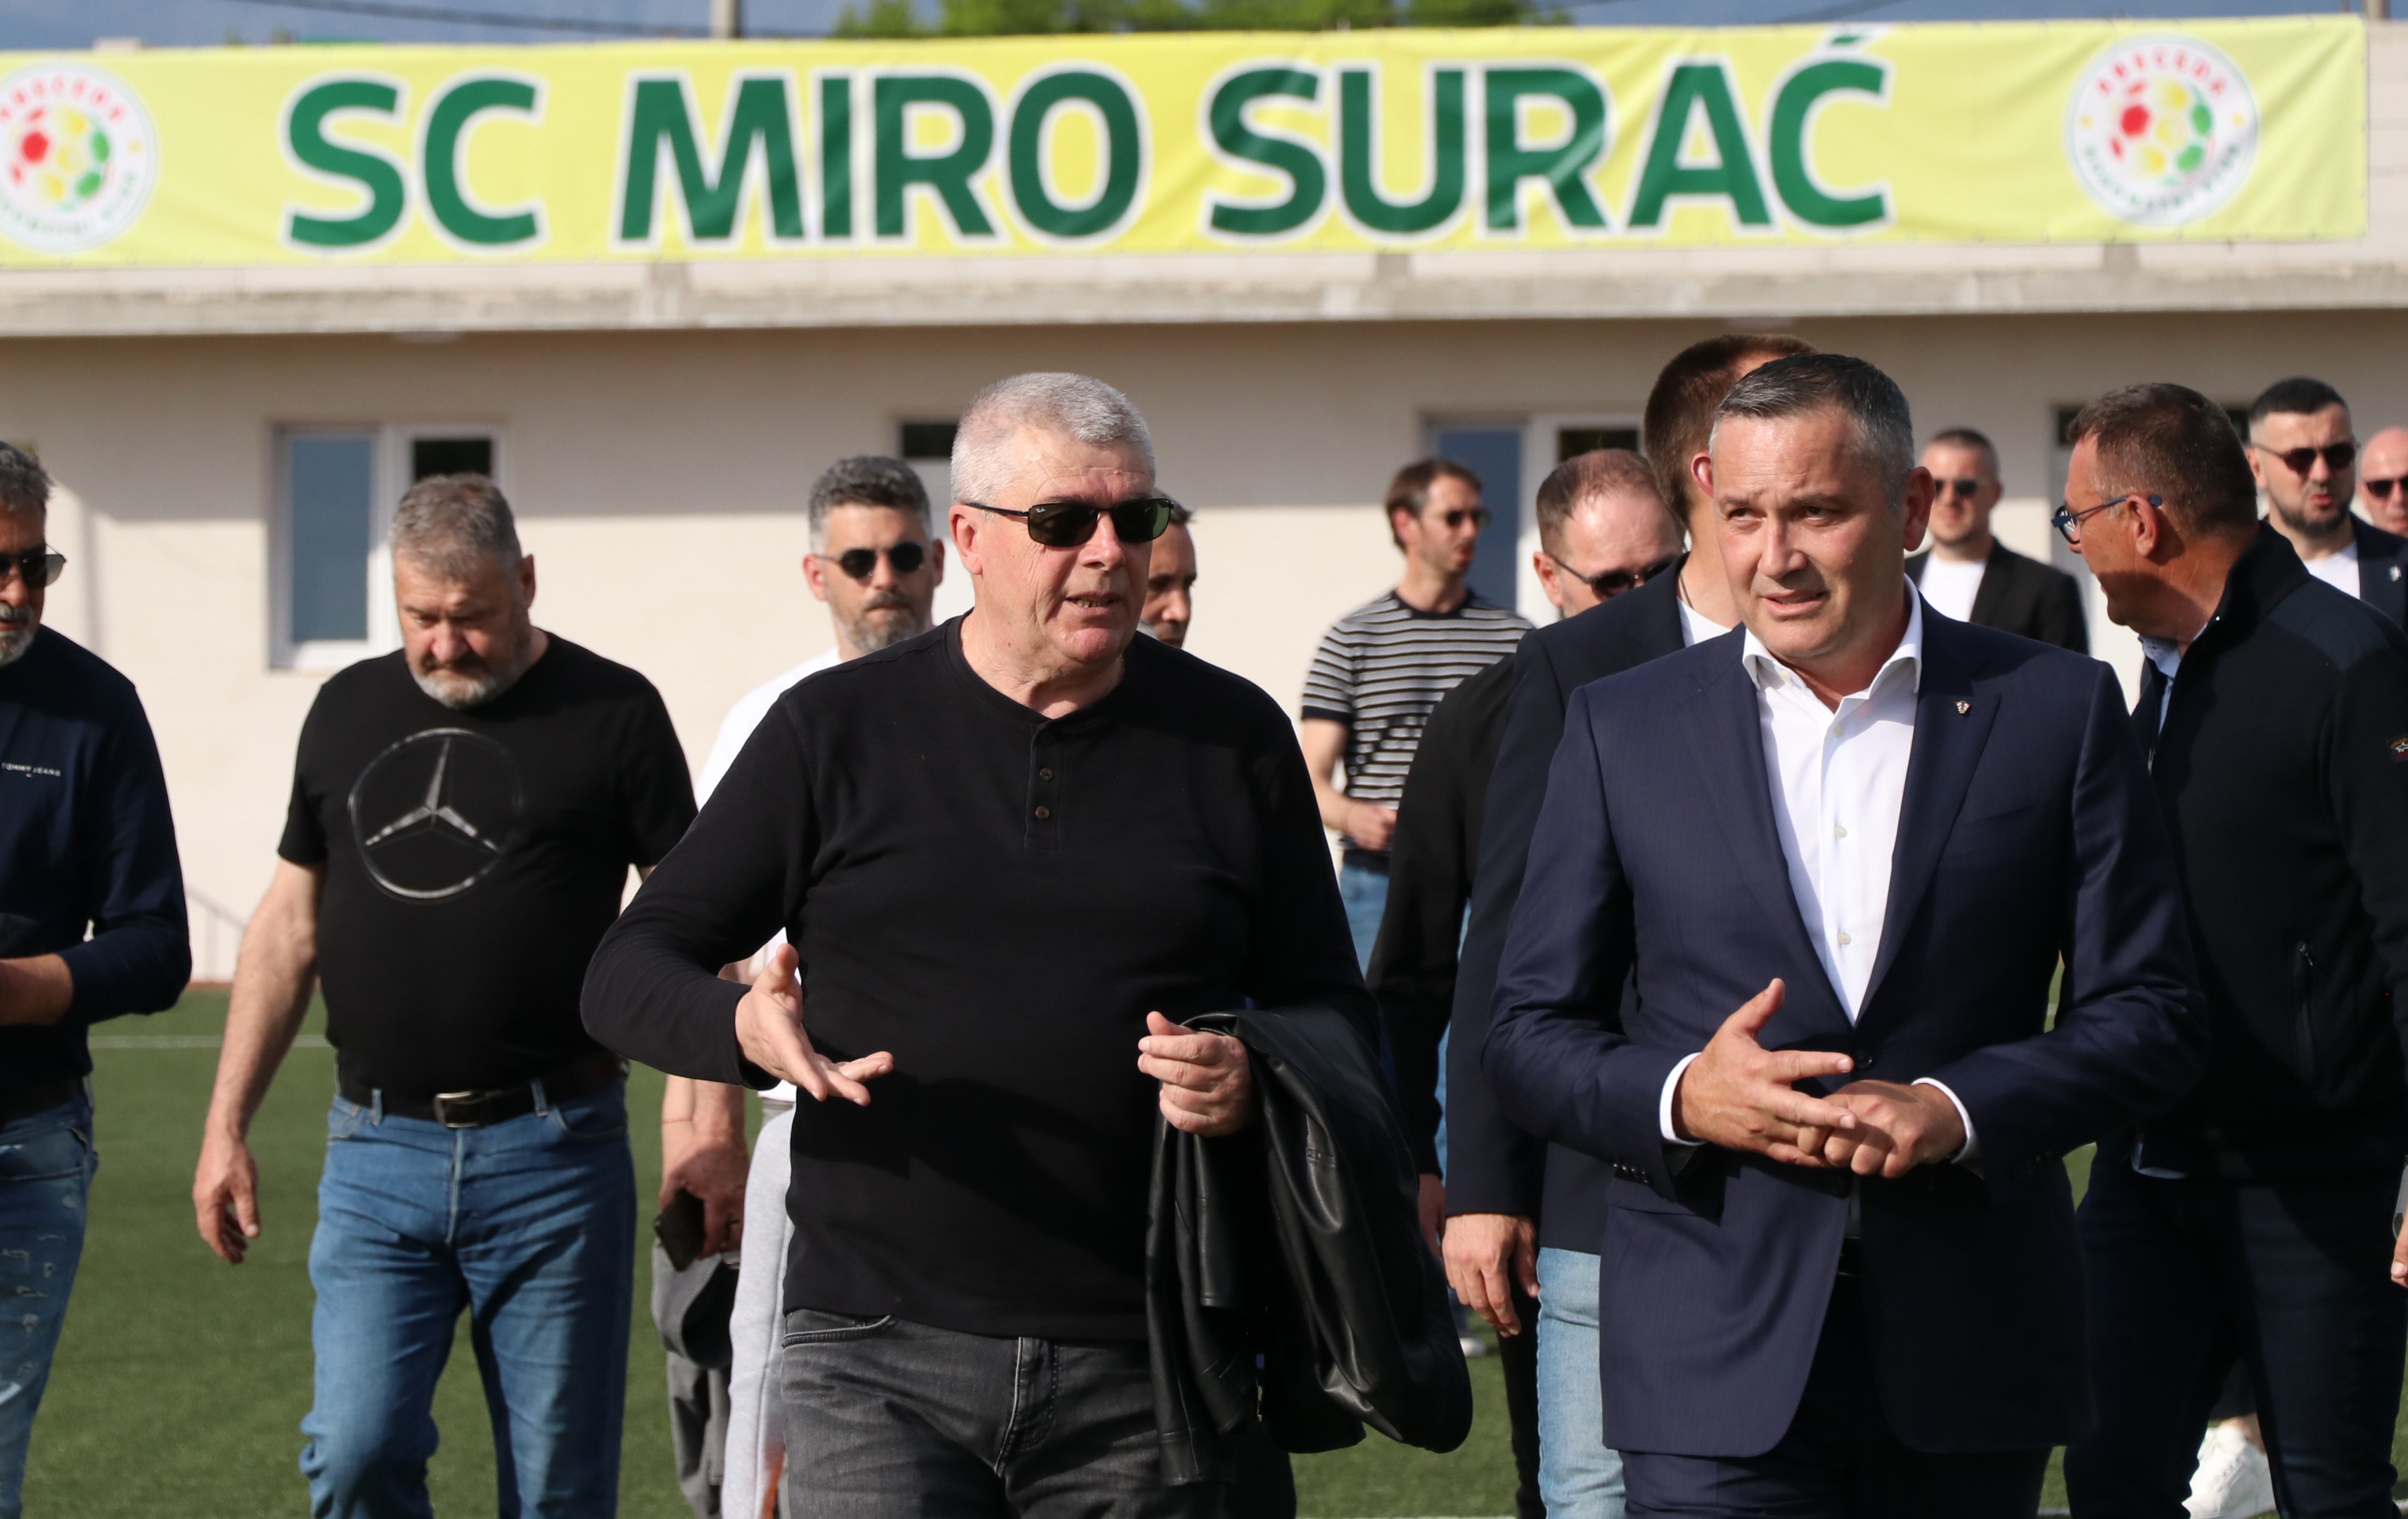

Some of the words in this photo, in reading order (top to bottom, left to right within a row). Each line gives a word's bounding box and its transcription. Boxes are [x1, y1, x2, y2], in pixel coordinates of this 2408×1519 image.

[288, 79, 537, 246] SC
[620, 71, 1141, 240] MIRO
[1208, 32, 1888, 234] SURAĆ
